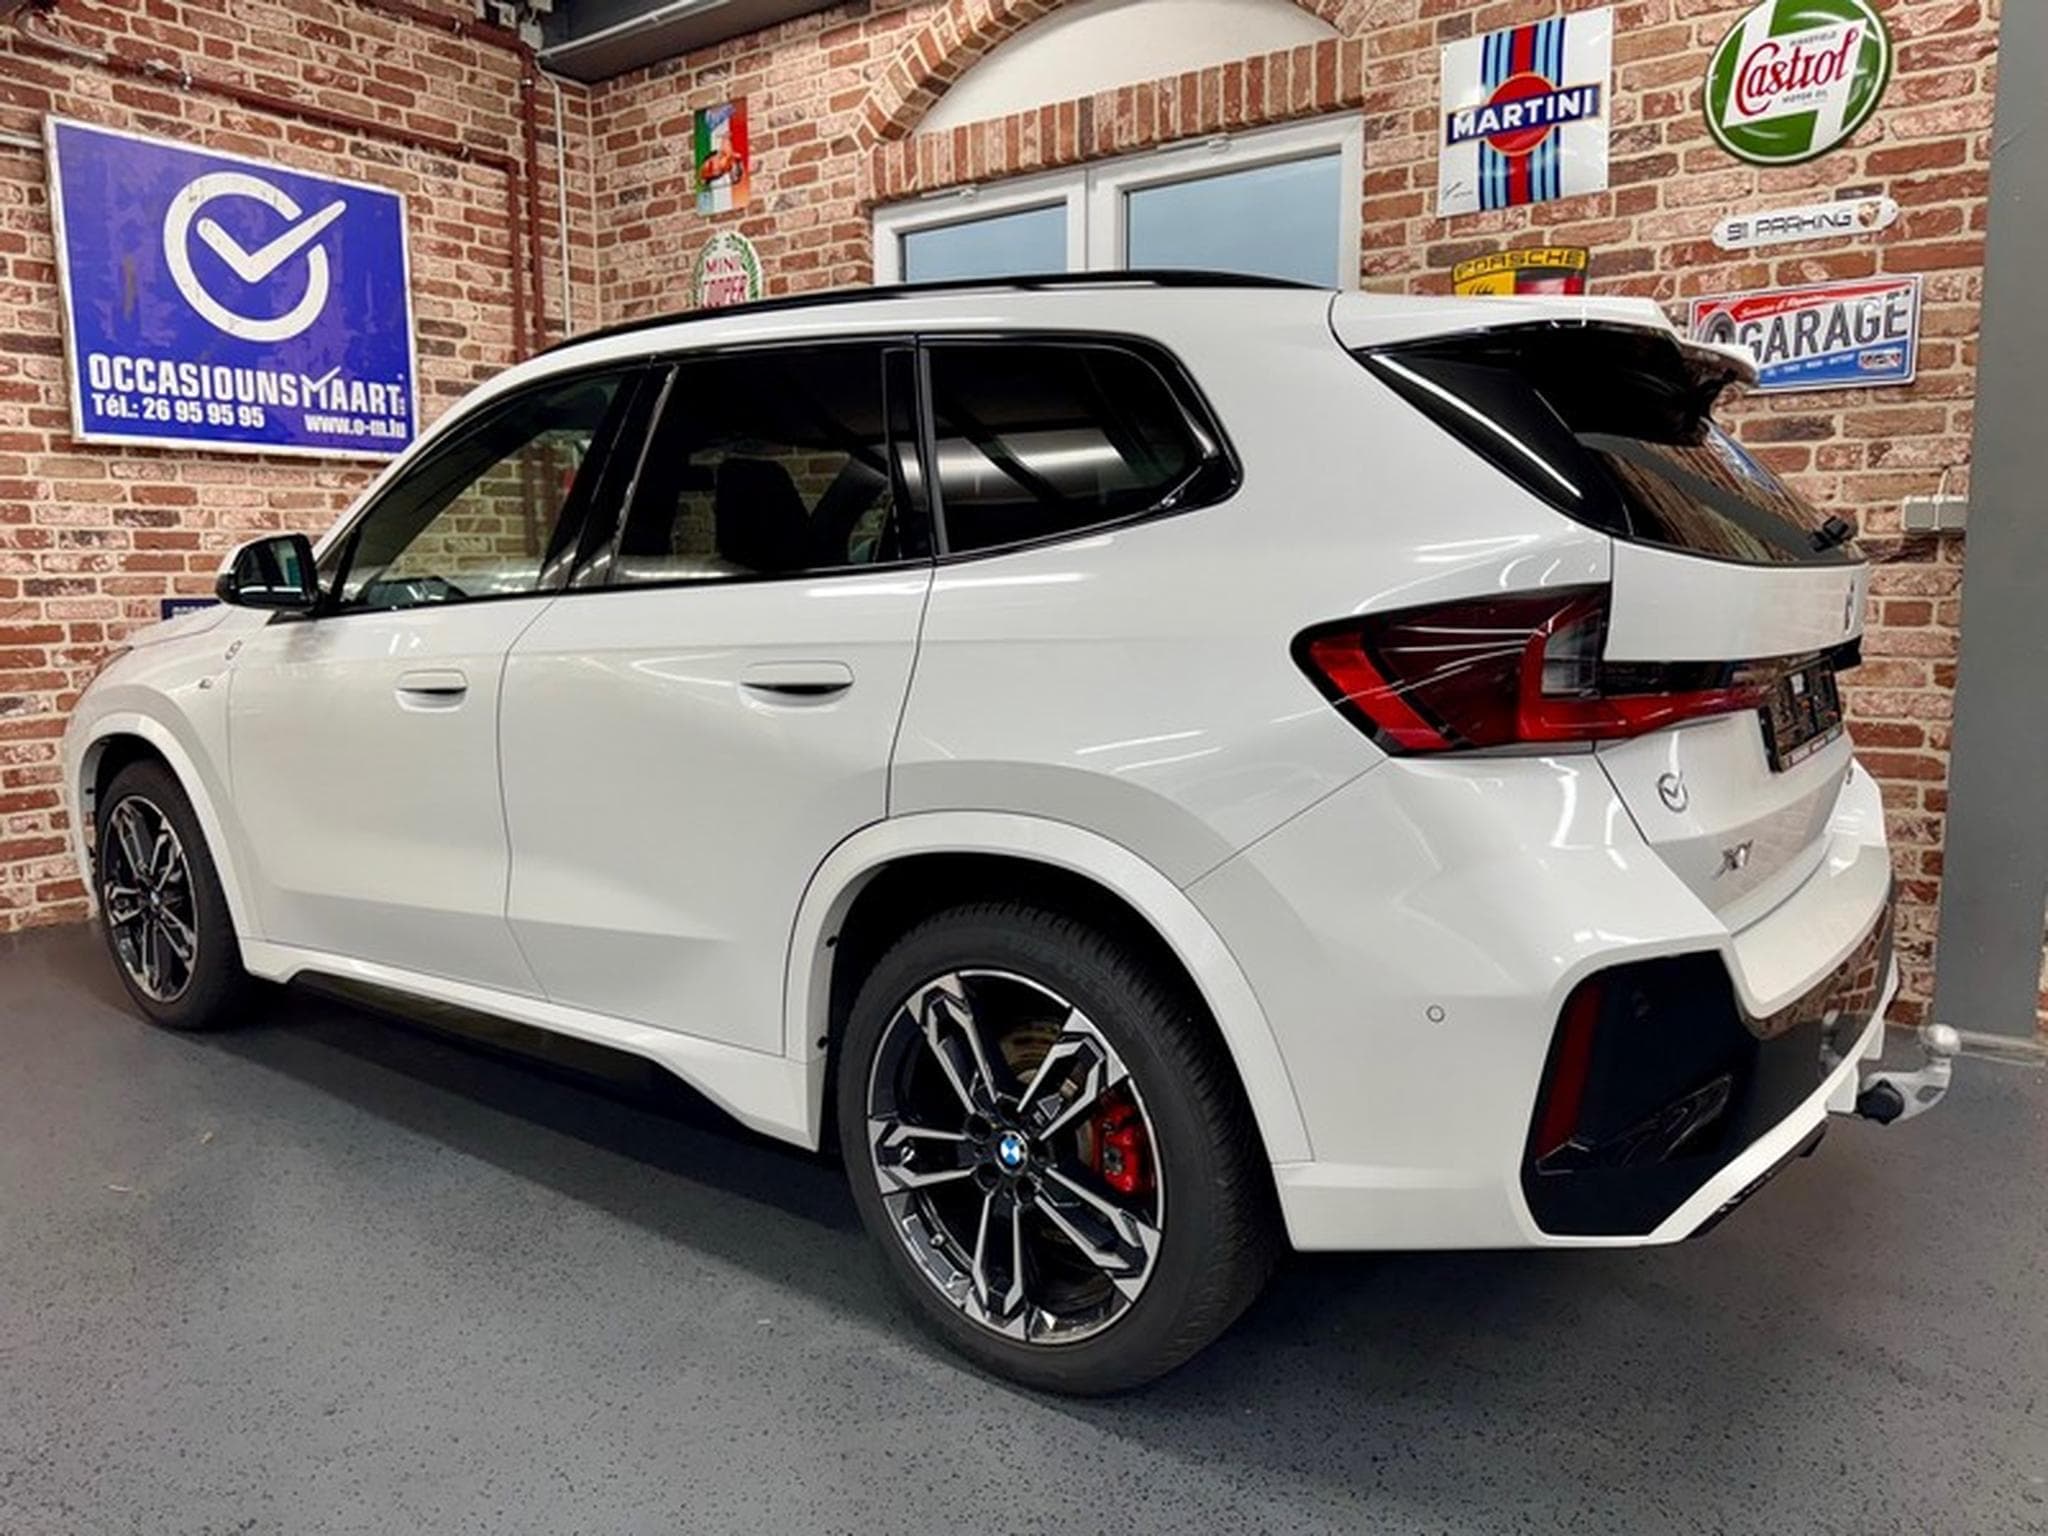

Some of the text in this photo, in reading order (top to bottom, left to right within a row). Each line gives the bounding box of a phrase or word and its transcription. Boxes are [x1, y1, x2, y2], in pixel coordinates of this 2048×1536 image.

[1735, 27, 1860, 116] Castrol
[1453, 88, 1593, 140] MARTINI
[1755, 210, 1852, 237] PARKING
[1456, 249, 1583, 278] PORSCHE
[1738, 291, 1909, 365] GARAGE
[142, 396, 171, 422] 26
[175, 400, 203, 424] 95
[206, 402, 235, 427] 95
[238, 405, 265, 429] 95
[303, 413, 407, 439] www.o-m.lu
